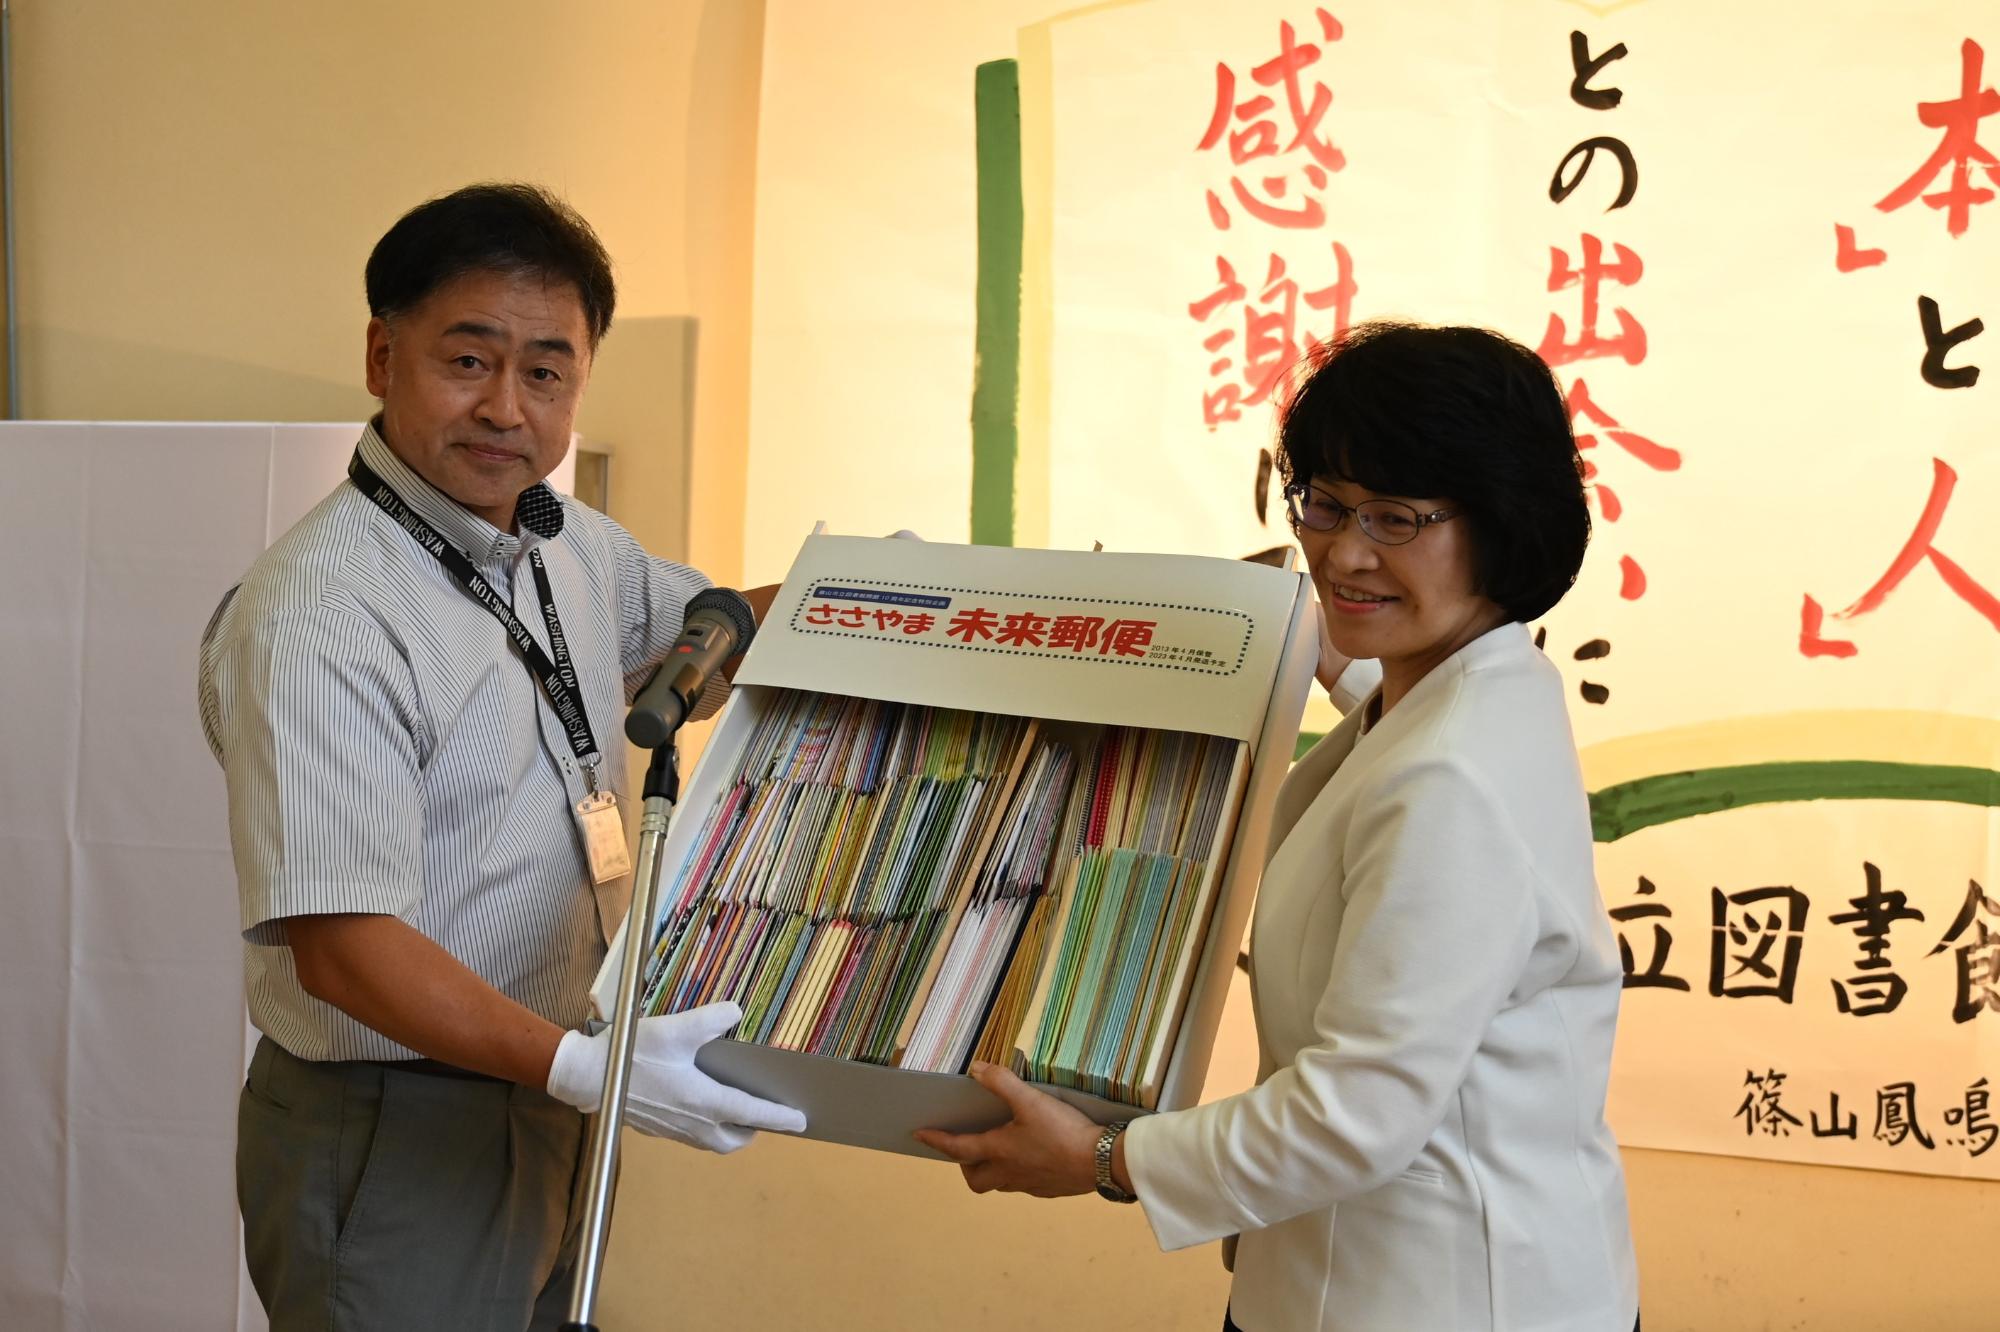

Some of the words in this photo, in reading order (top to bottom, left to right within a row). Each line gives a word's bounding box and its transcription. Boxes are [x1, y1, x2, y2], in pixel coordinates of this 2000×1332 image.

[373, 485, 445, 557] WASHINGTON
[469, 575, 532, 652] WASHINGTON
[544, 603, 576, 688] WASHINGTON
[804, 604, 935, 636] ささやま
[946, 608, 1158, 659] 未来郵便
[545, 672, 591, 753] WASHINGTON
